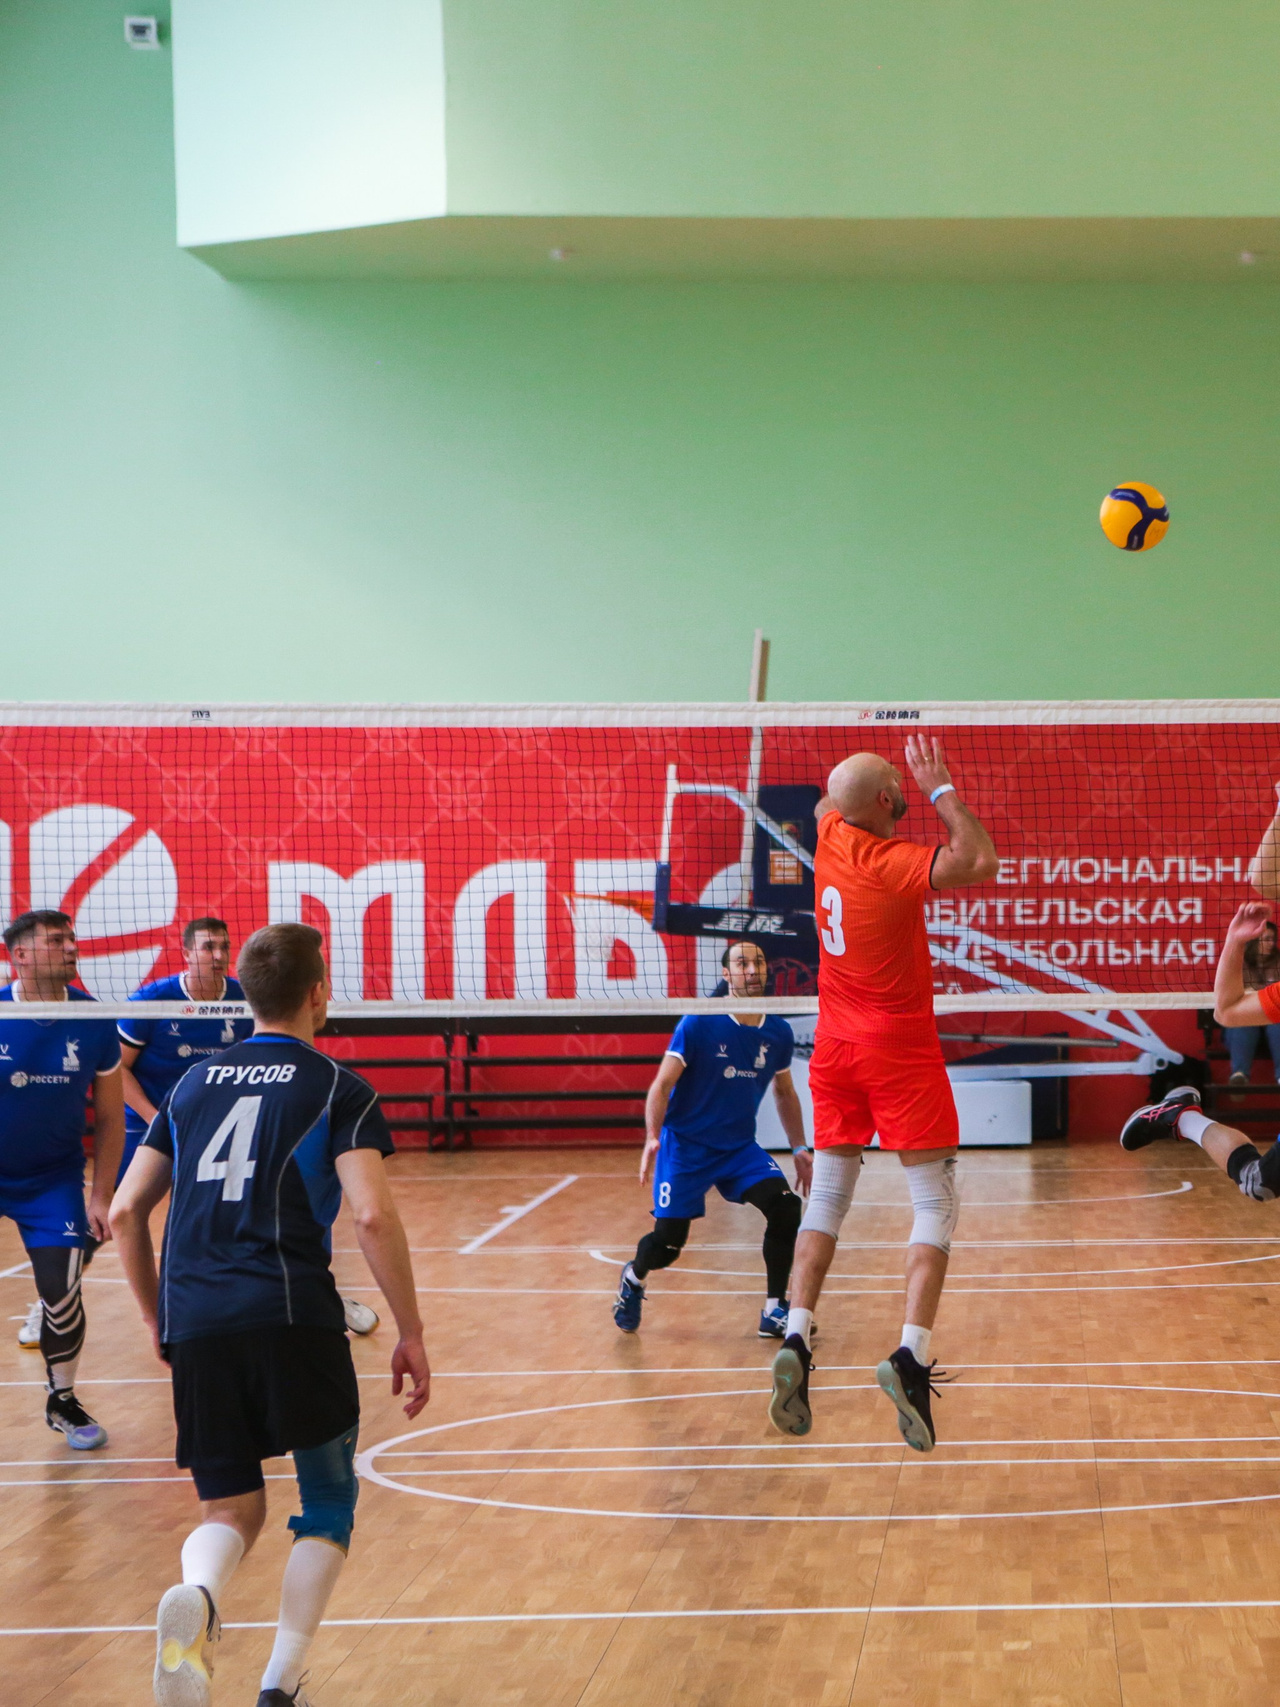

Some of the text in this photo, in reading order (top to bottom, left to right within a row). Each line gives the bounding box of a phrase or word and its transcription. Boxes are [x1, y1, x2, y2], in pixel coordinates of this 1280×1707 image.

[191, 710, 211, 719] FIVB
[821, 885, 847, 957] 3
[29, 1074, 70, 1084] РОССЕТИ
[205, 1063, 297, 1085] ТРУСОВ
[196, 1095, 263, 1202] 4
[658, 1181, 672, 1208] 8
